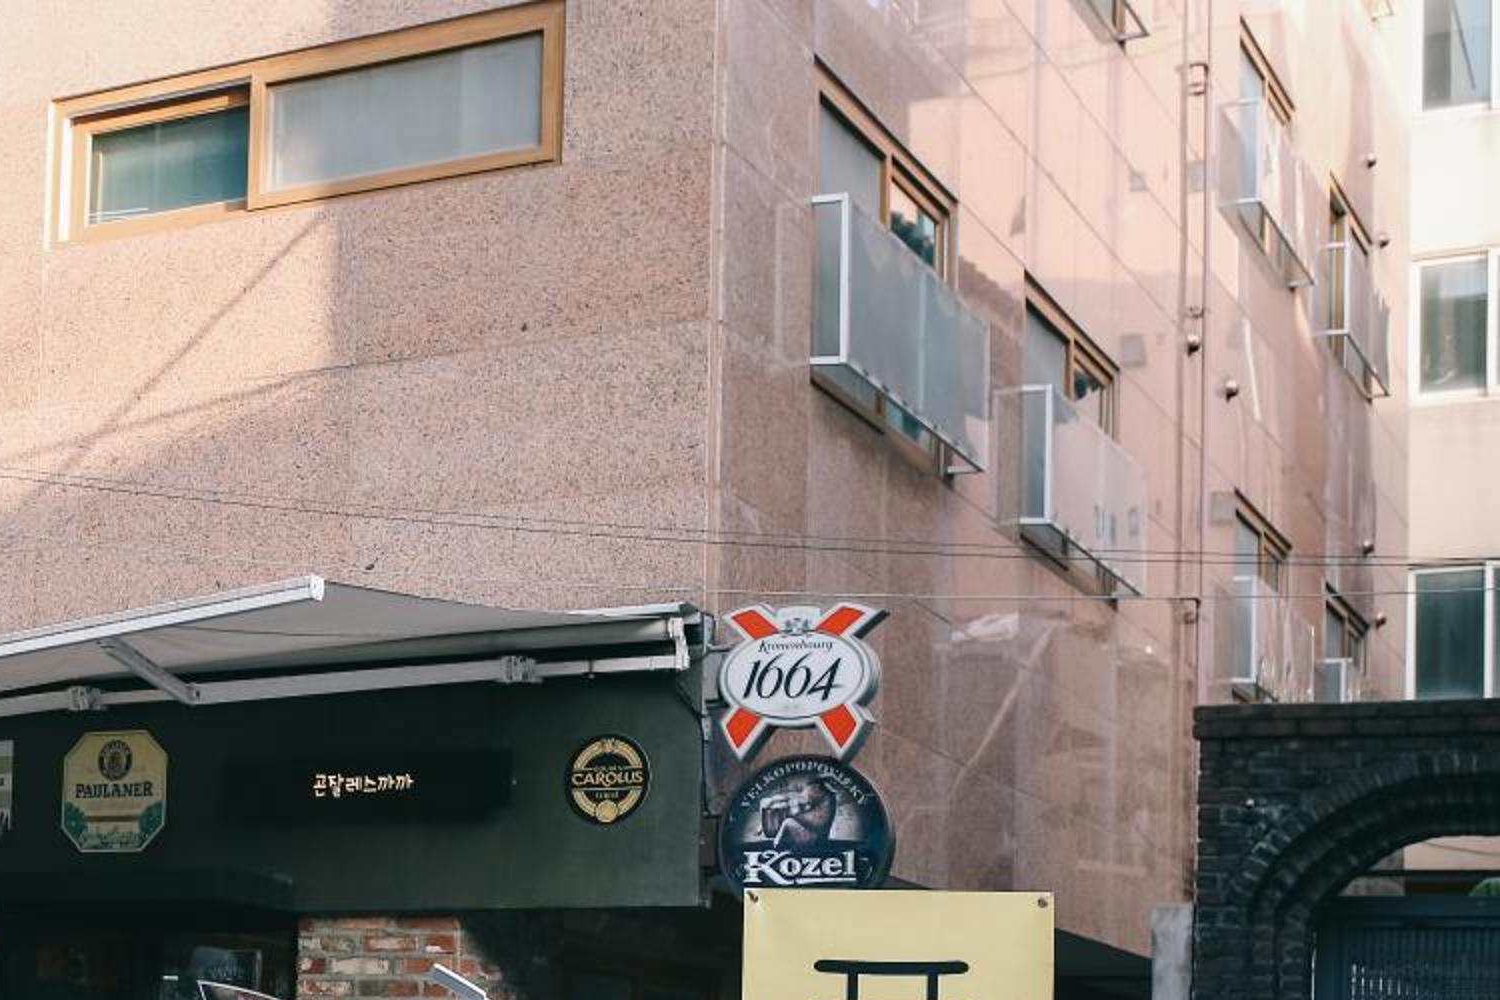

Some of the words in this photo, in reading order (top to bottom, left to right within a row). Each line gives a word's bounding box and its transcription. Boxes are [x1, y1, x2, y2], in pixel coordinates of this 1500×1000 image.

[758, 639, 834, 654] Kronenbourg
[743, 653, 843, 701] 1664
[572, 770, 644, 787] CAROLUS
[75, 782, 153, 799] PAULANER
[743, 850, 857, 886] Kozel
